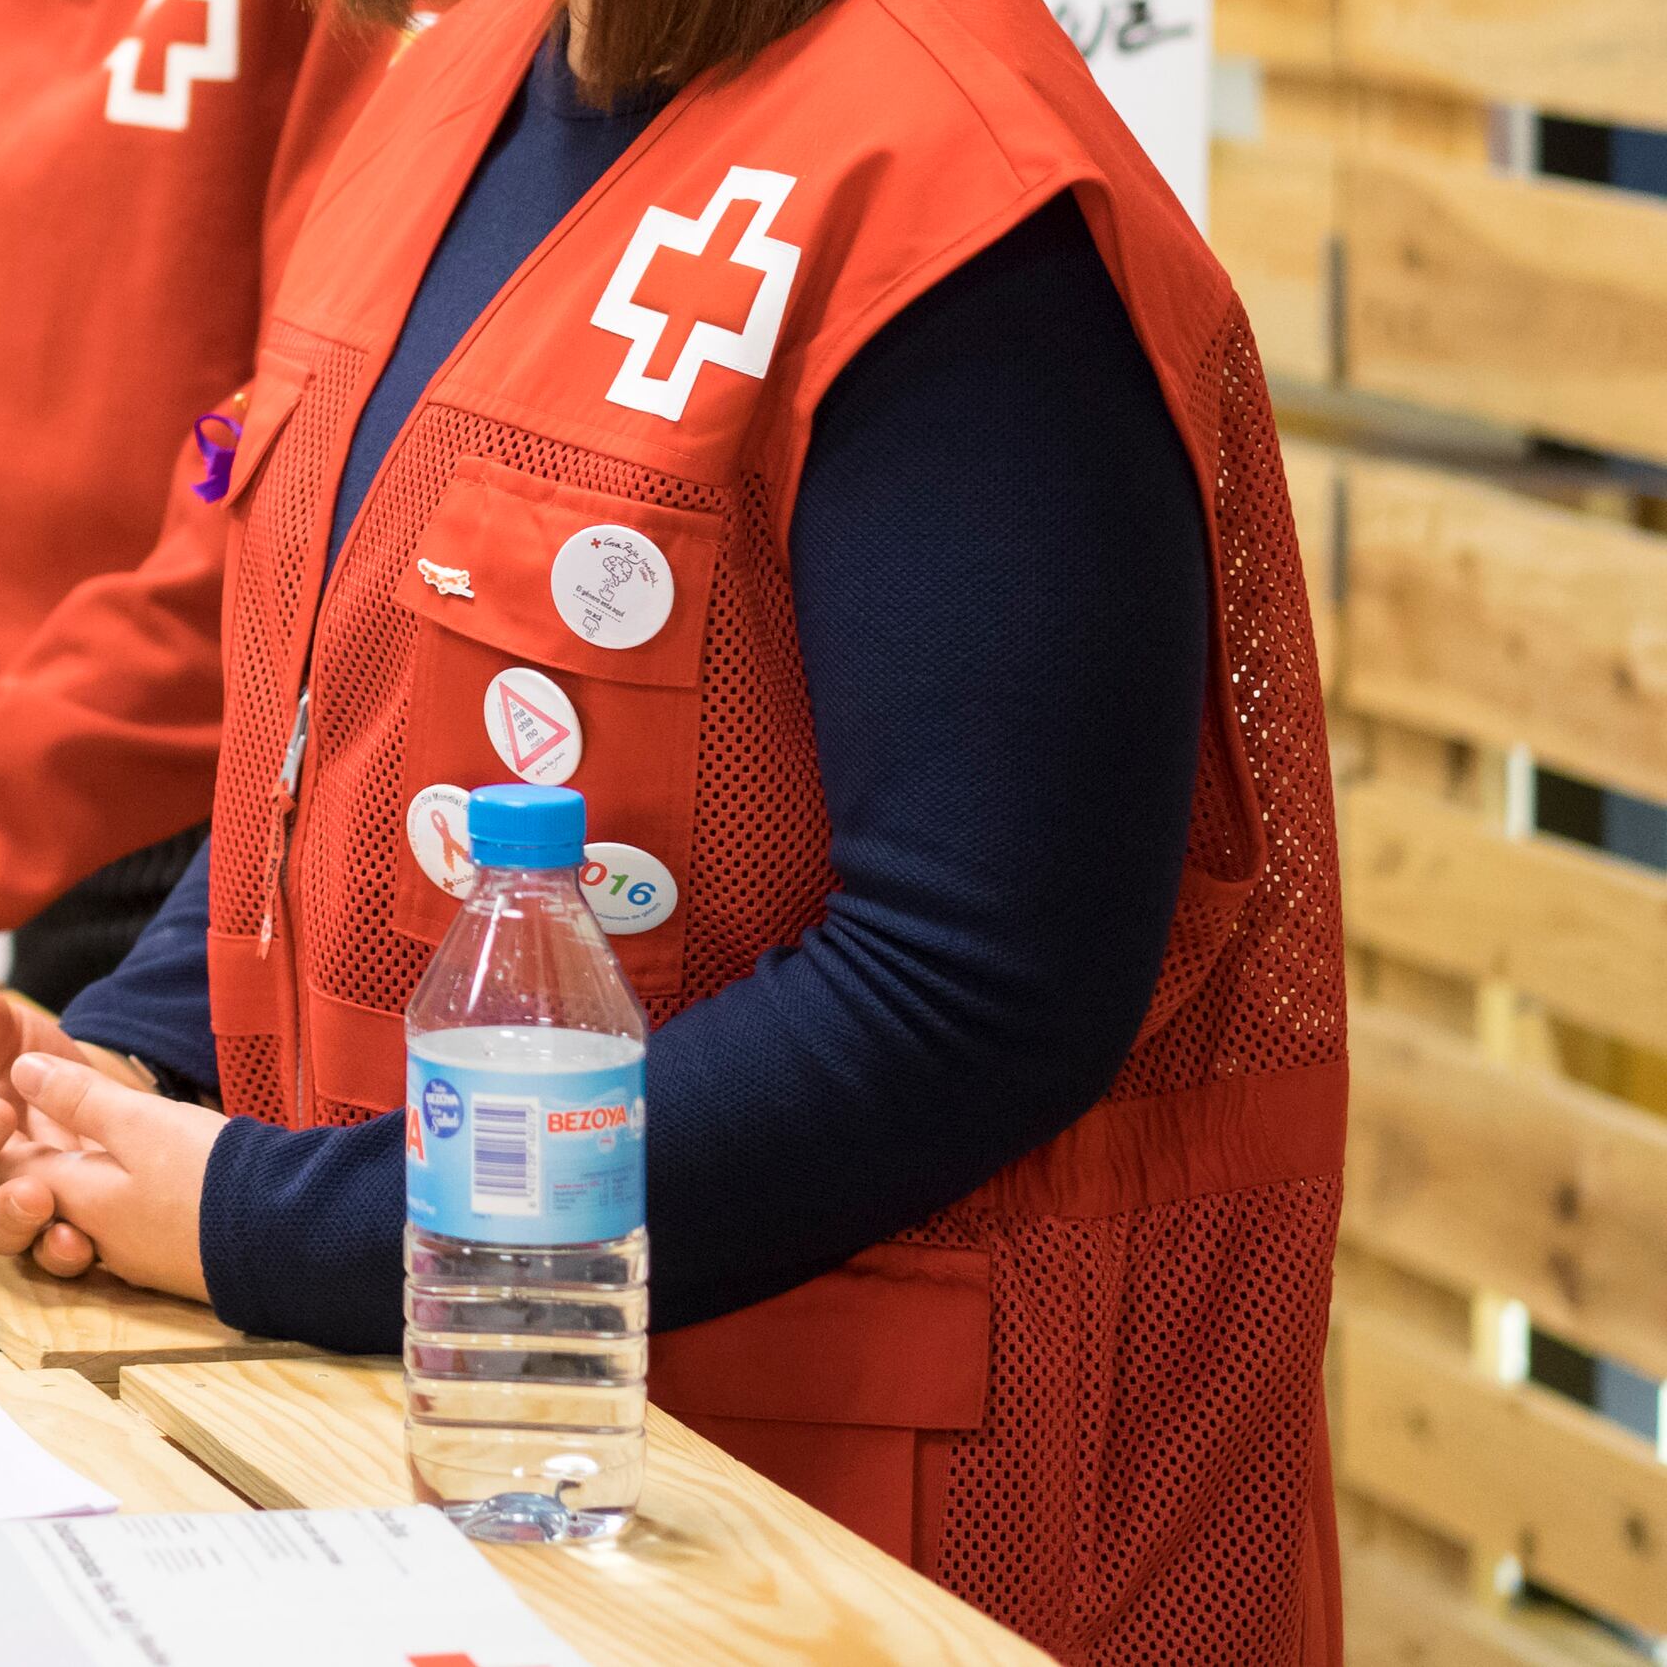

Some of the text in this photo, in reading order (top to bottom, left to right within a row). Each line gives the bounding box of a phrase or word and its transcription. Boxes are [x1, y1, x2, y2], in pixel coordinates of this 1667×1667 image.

[514, 708, 527, 722] ma
[525, 728, 539, 741] mo
[578, 861, 657, 906] 016
[547, 1105, 628, 1133] BEZOYA
